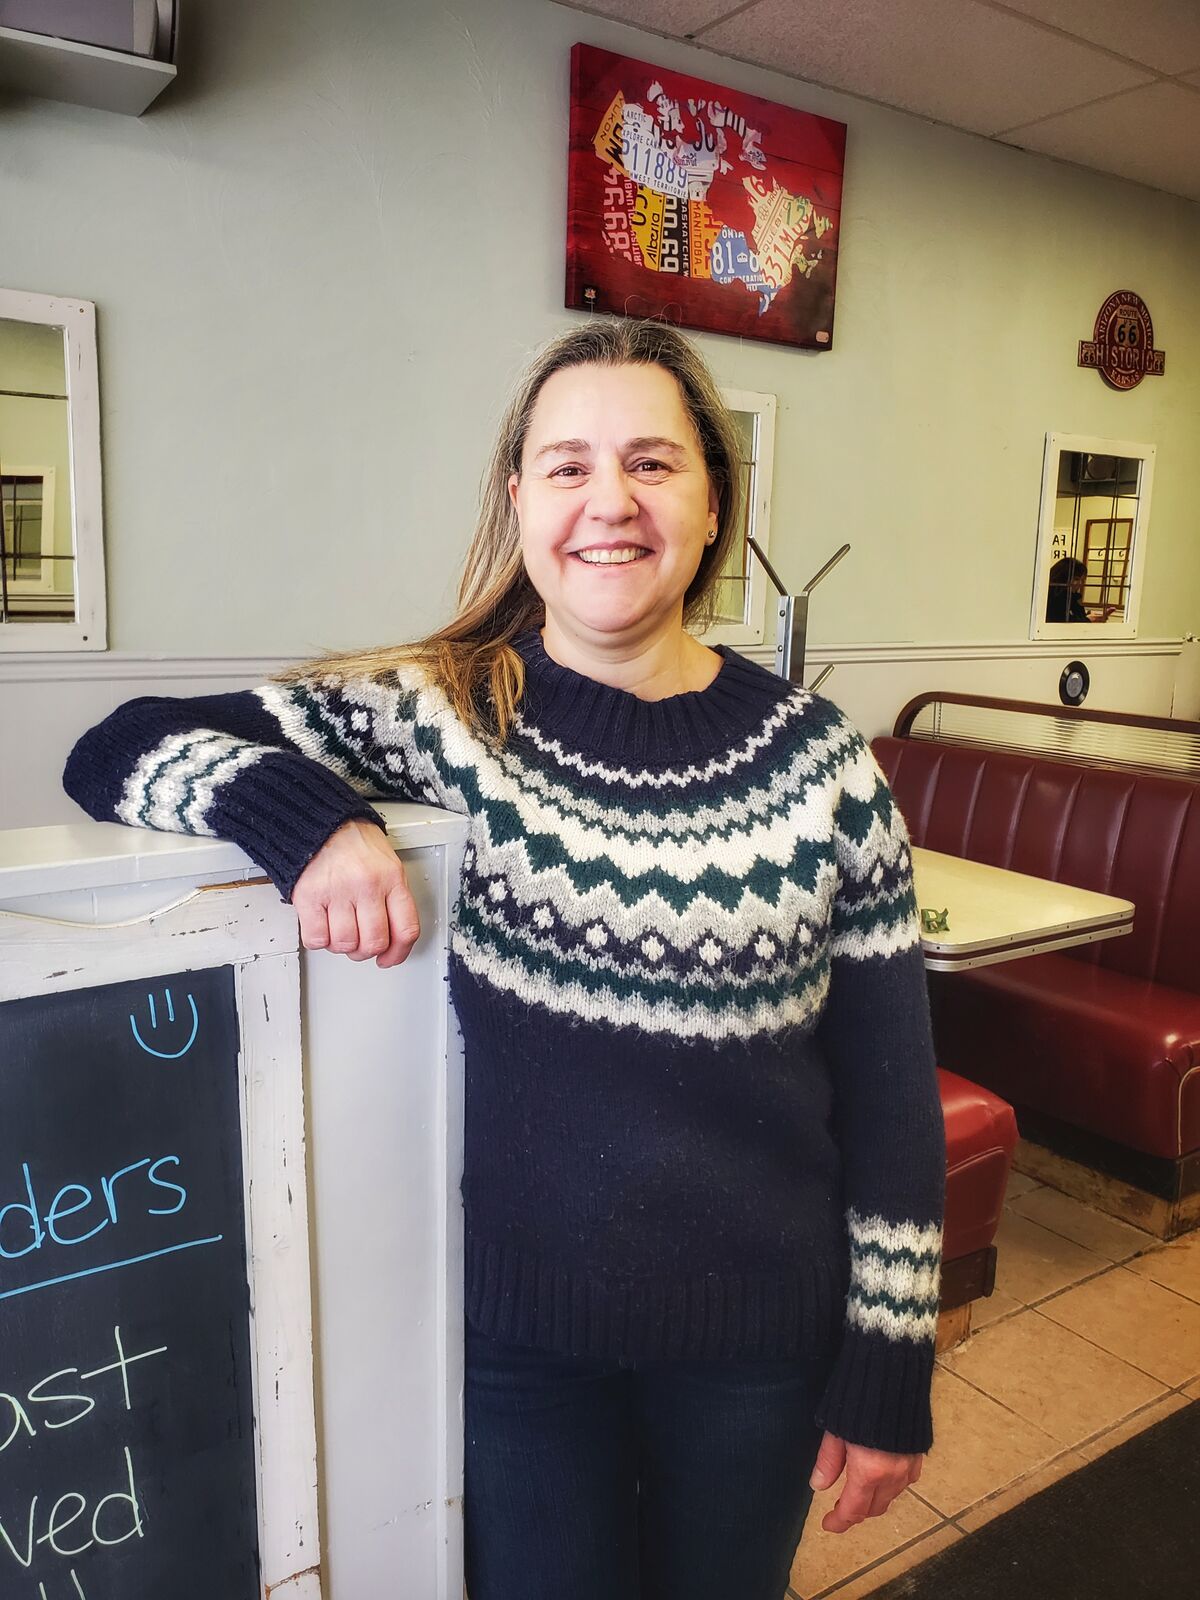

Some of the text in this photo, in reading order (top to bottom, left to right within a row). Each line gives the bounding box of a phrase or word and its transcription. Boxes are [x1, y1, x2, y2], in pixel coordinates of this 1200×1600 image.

[693, 201, 703, 265] MANITOBA
[1117, 324, 1137, 344] 66
[1096, 343, 1154, 371] HISTORIC
[1111, 369, 1140, 384] KANSAS
[0, 1155, 187, 1259] ders
